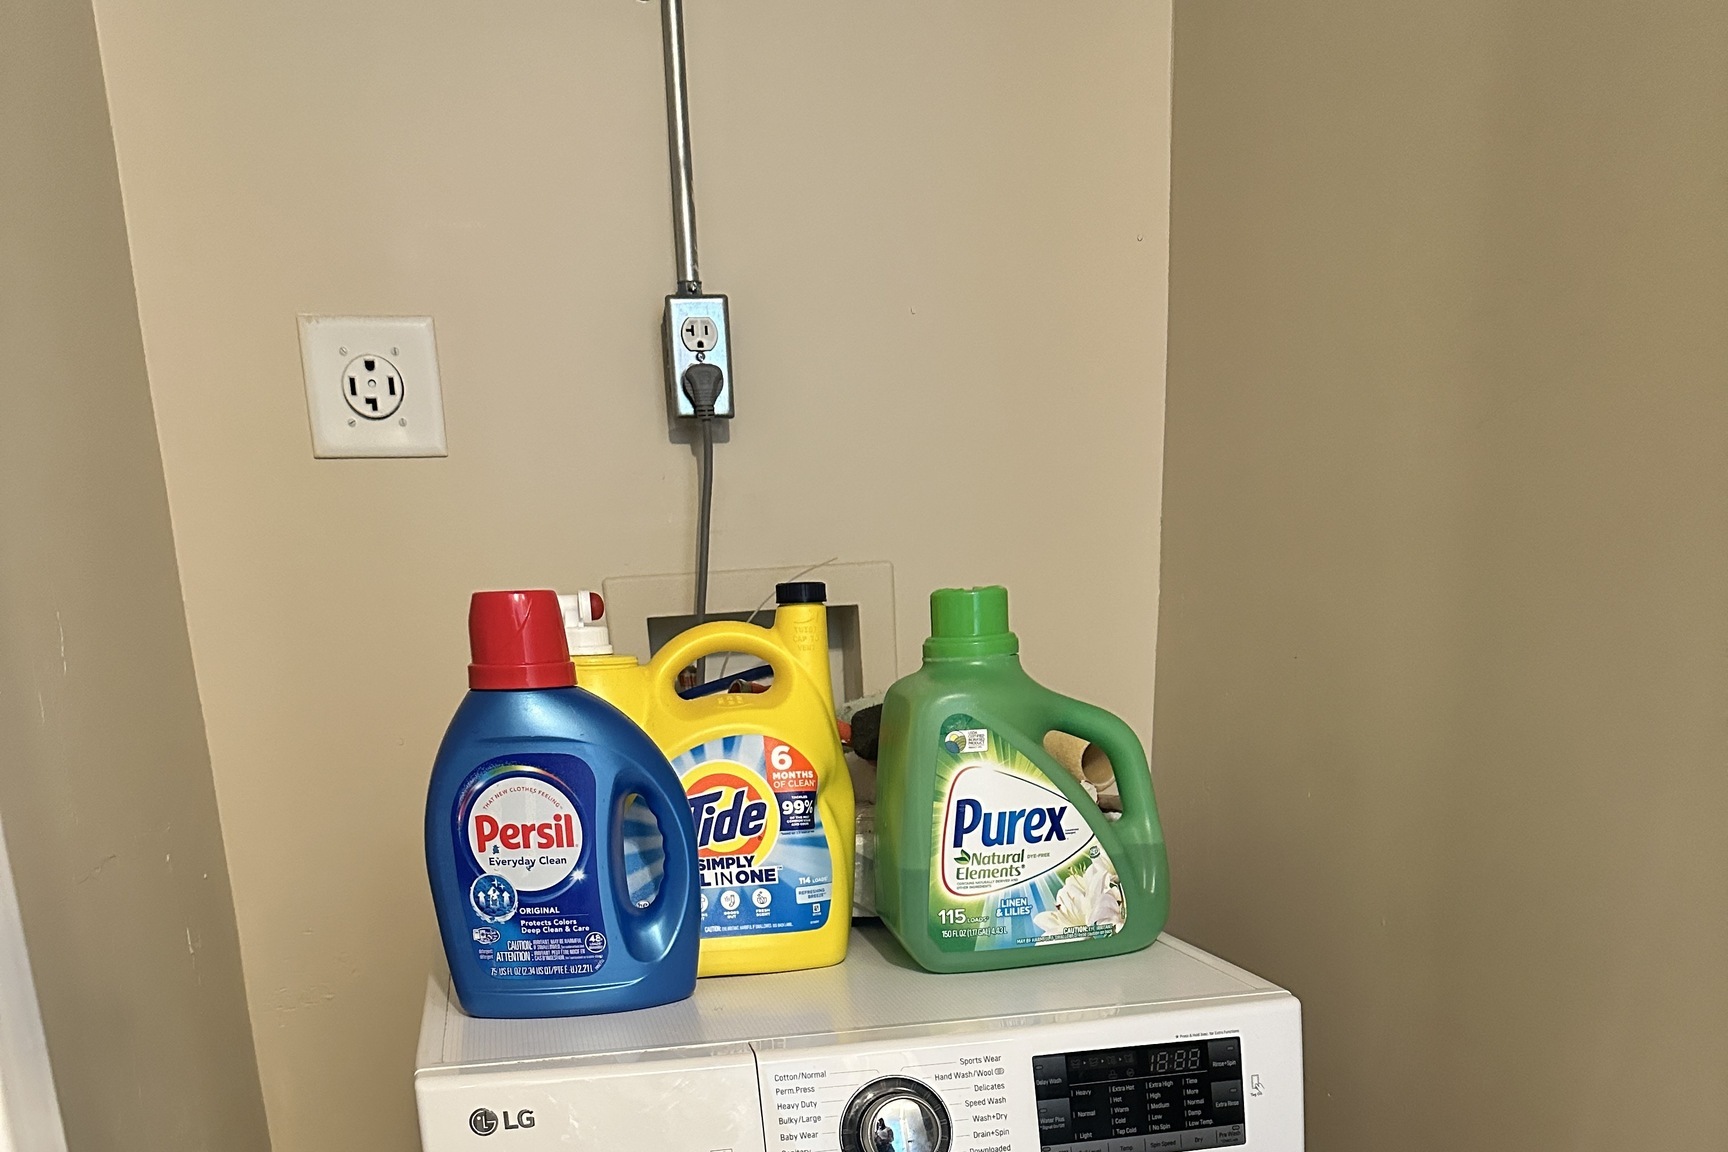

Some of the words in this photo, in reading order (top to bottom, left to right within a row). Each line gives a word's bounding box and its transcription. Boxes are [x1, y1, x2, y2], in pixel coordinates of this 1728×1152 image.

[771, 745, 793, 770] 6
[772, 770, 814, 780] MONTHS
[774, 780, 786, 788] OF
[788, 780, 815, 788] CLEAN
[483, 797, 494, 809] THAT
[495, 789, 508, 799] NEW
[510, 786, 537, 794] CLOTHES
[538, 790, 560, 808] FEELING
[782, 800, 813, 815] 99%
[690, 790, 767, 848] Tide
[953, 798, 1068, 848] Purex
[475, 814, 575, 853] Persil
[489, 857, 536, 868] Everyday
[539, 856, 567, 865] Clean
[699, 855, 755, 871] SIMPLY
[971, 849, 1025, 866] Natural
[715, 872, 733, 886] IN
[736, 868, 777, 884] ONE
[956, 864, 1022, 880] Elements
[799, 876, 811, 885] 114
[1001, 898, 1027, 908] LINEN
[520, 907, 560, 915] ORIGINAL
[996, 909, 1004, 917] &
[1004, 906, 1031, 917] LILIES
[938, 909, 966, 925] 115
[960, 1057, 982, 1066] Sports
[983, 1055, 1001, 1063] Wear
[774, 1070, 827, 1082] Cotton/Normal
[935, 1073, 952, 1081] Hand
[954, 1069, 994, 1080] Wash/Wool
[974, 1083, 1005, 1092] Delicates
[777, 1102, 799, 1111] Heavy
[801, 1100, 818, 1109] Duty
[965, 1098, 986, 1107] Speed
[972, 1112, 1008, 1122] Wash+Dry
[1188, 1109, 1202, 1117] Damp
[503, 1110, 535, 1130] LG
[778, 1114, 821, 1125] Bulky/Large
[780, 1132, 798, 1142] Baby
[799, 1131, 818, 1140] Wear
[974, 1128, 1010, 1139] Drain+Spin
